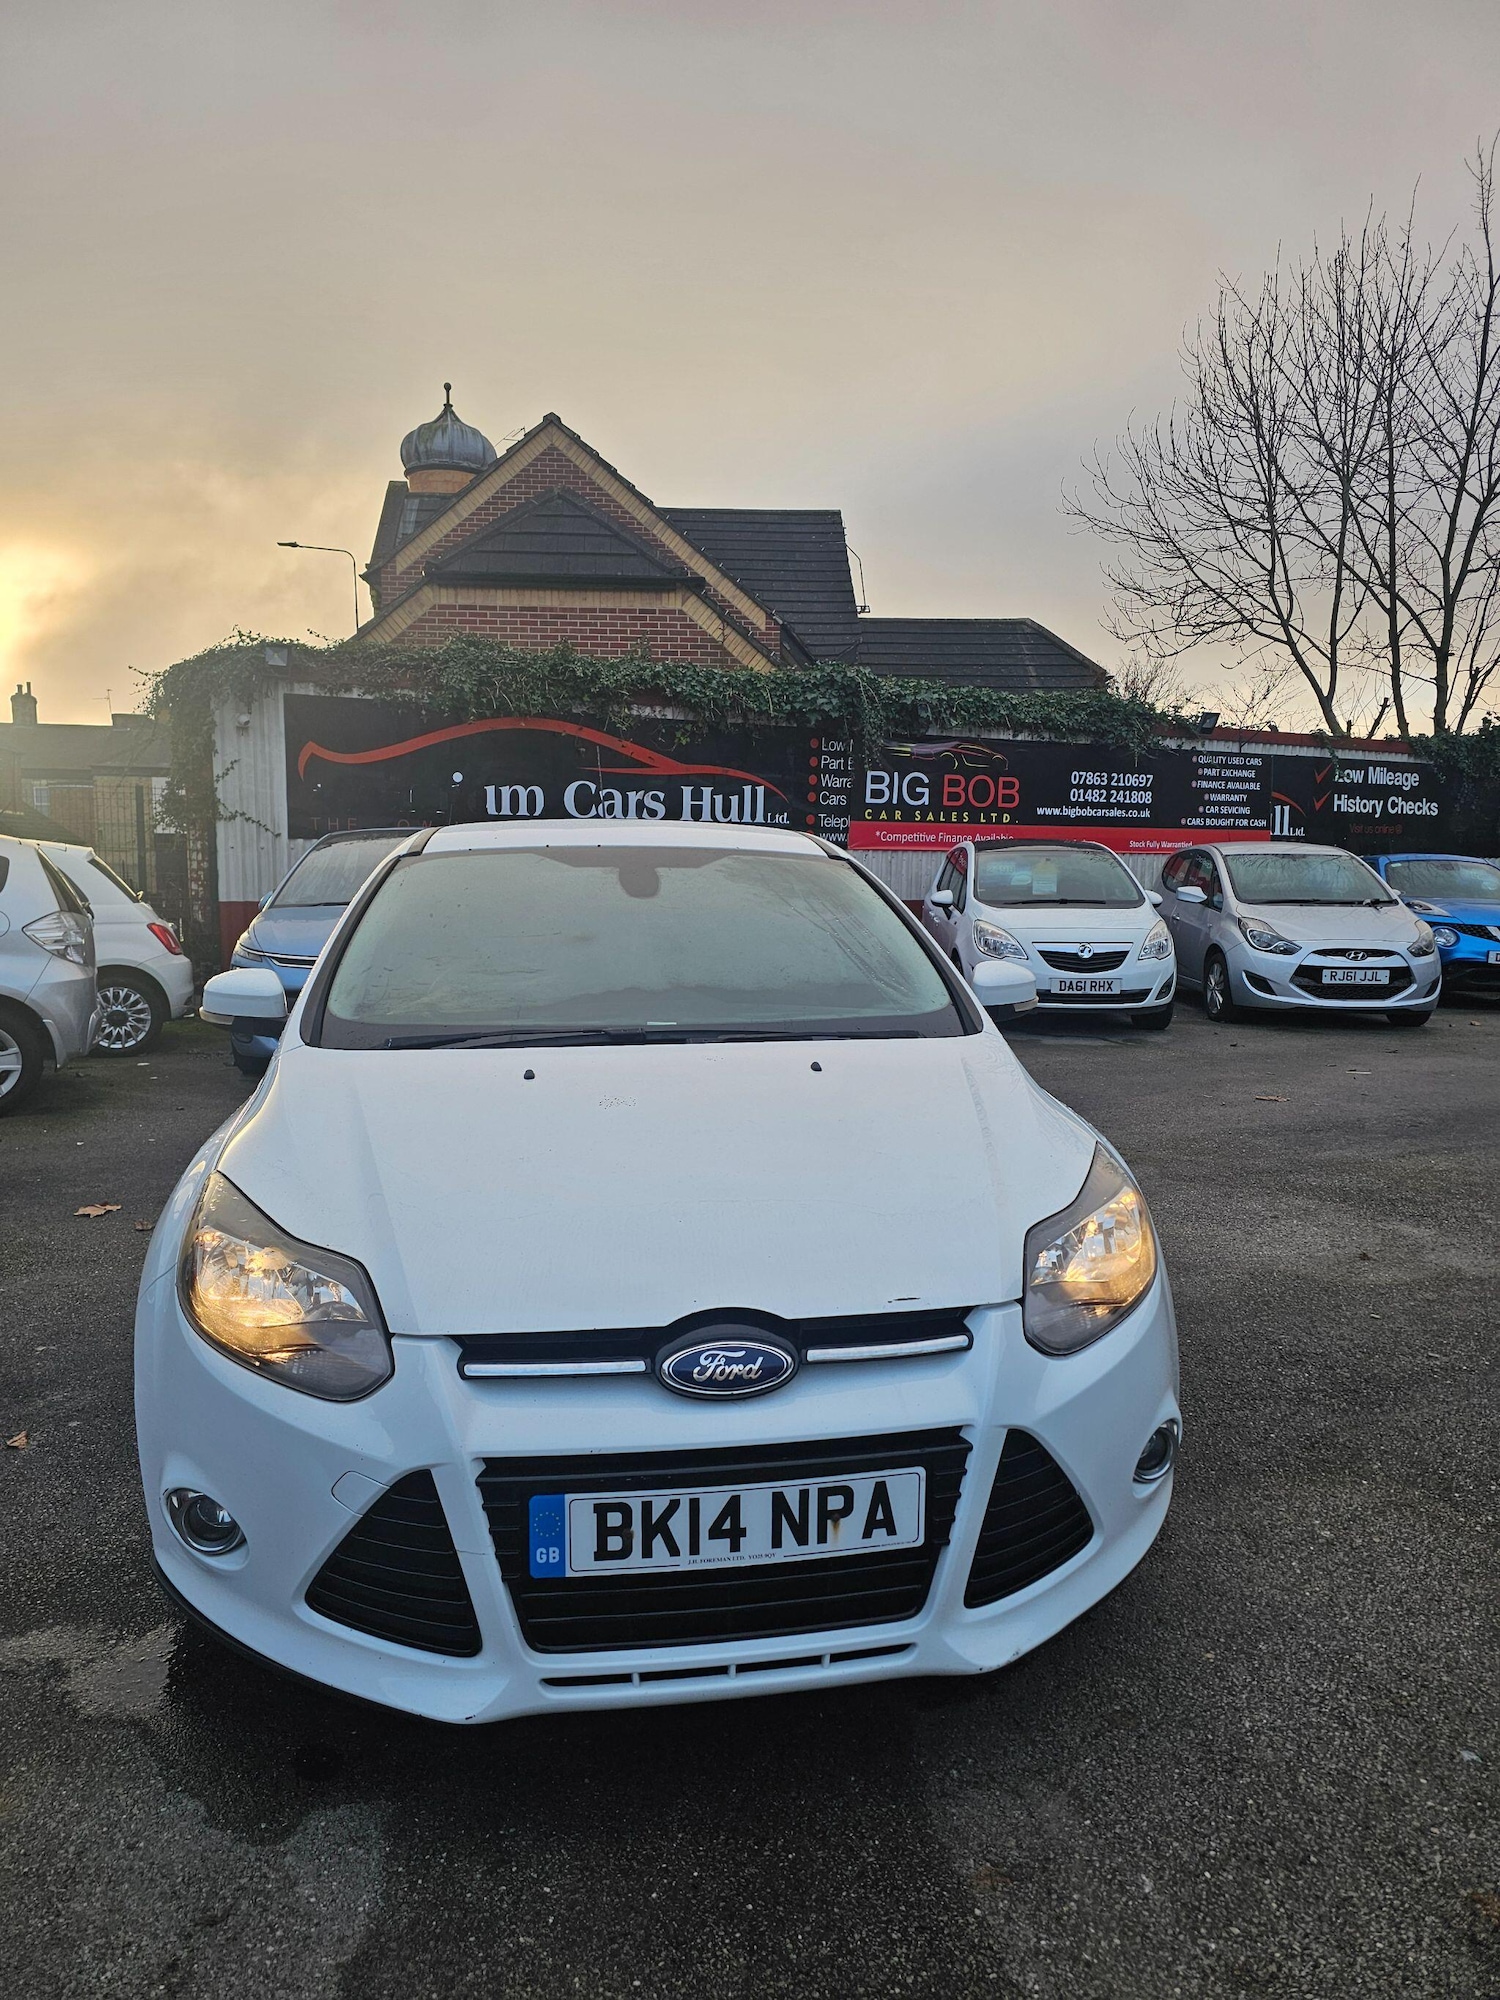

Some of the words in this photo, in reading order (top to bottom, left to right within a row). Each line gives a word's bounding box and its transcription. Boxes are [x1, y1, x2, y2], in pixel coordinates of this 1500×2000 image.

[821, 755, 845, 770] Part
[1198, 755, 1227, 764] QUALITY
[1227, 756, 1245, 765] USED
[1245, 757, 1262, 766] CARS
[1071, 771, 1108, 785] 07863
[1110, 773, 1154, 787] 210697
[1203, 767, 1220, 776] PART
[1221, 768, 1256, 778] EXCHANGE
[1367, 766, 1420, 790] Mileage
[865, 770, 930, 806] BIG
[942, 774, 1020, 809] BOB
[1197, 780, 1226, 789] FINANCE
[563, 780, 667, 820] Cars
[680, 785, 766, 824] Hull
[766, 812, 790, 824] Ltd.
[820, 791, 848, 806] Cars
[1070, 788, 1107, 803] 01482
[1109, 790, 1153, 804] 241808
[1209, 793, 1248, 802] WARRANTY
[1036, 806, 1151, 818] www.bigbobcarsales.co.uk
[1205, 806, 1219, 814] CAR
[1333, 794, 1384, 818] History
[1387, 796, 1439, 817] Checks
[864, 808, 902, 821] CAR
[915, 810, 970, 822] SALES
[980, 812, 1019, 824] LTD.
[1186, 818, 1205, 826] CARS
[1205, 818, 1235, 827] BOUGHT
[1235, 818, 1249, 827] FOR
[1249, 819, 1267, 827] CASH
[1270, 805, 1291, 836] ll
[938, 832, 972, 843] Finance
[1129, 840, 1146, 848] Stock
[1146, 840, 1160, 849] Fully
[1160, 841, 1193, 849] Warrantied
[1329, 970, 1357, 982] RJ61
[1359, 971, 1382, 982] JJL
[1059, 980, 1086, 992] DA61
[1089, 980, 1114, 992] RHX
[692, 1350, 764, 1383] Ford
[593, 1495, 747, 1562] BK14
[771, 1480, 898, 1549] NPA
[536, 1547, 560, 1564] GB
